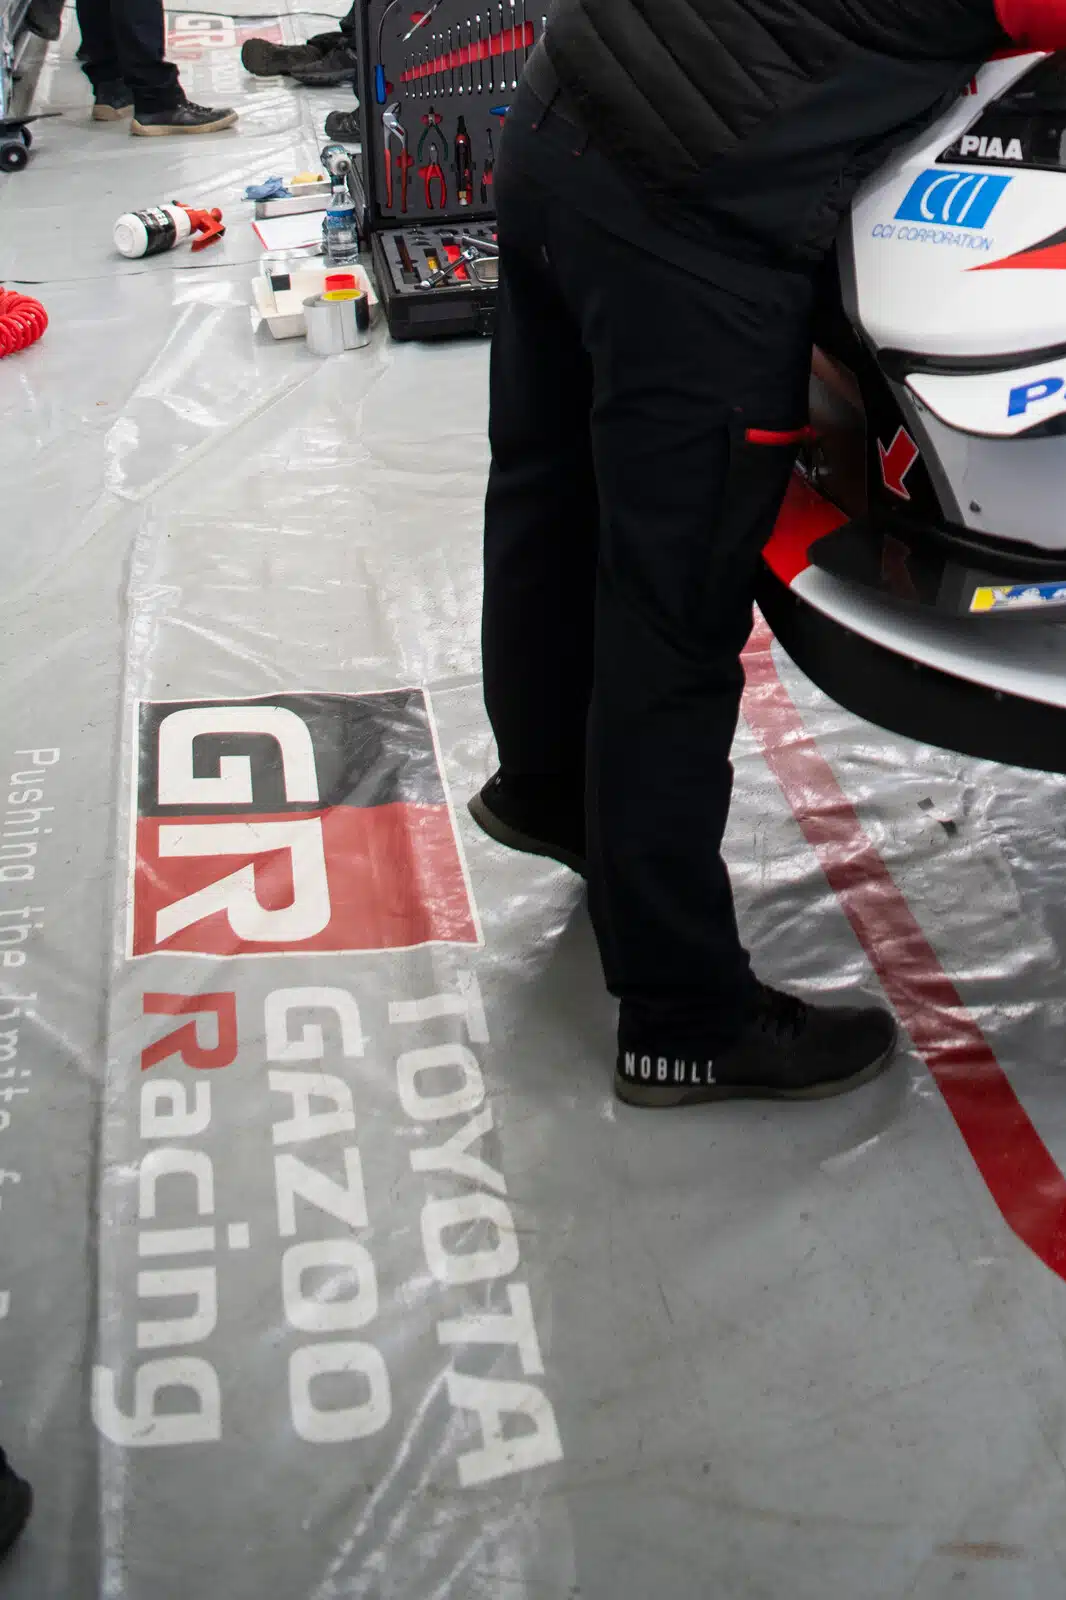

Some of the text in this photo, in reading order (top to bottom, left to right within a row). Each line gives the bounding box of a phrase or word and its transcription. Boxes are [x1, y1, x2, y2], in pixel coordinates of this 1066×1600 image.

[872, 224, 994, 251] CCI CORPORATION
[960, 135, 1023, 160] PIAA
[157, 705, 332, 945] GR
[624, 1051, 717, 1084] NOBULL
[91, 991, 251, 1449] Racing
[264, 986, 393, 1445] GAZOO
[389, 968, 564, 1489] TOYOTA
